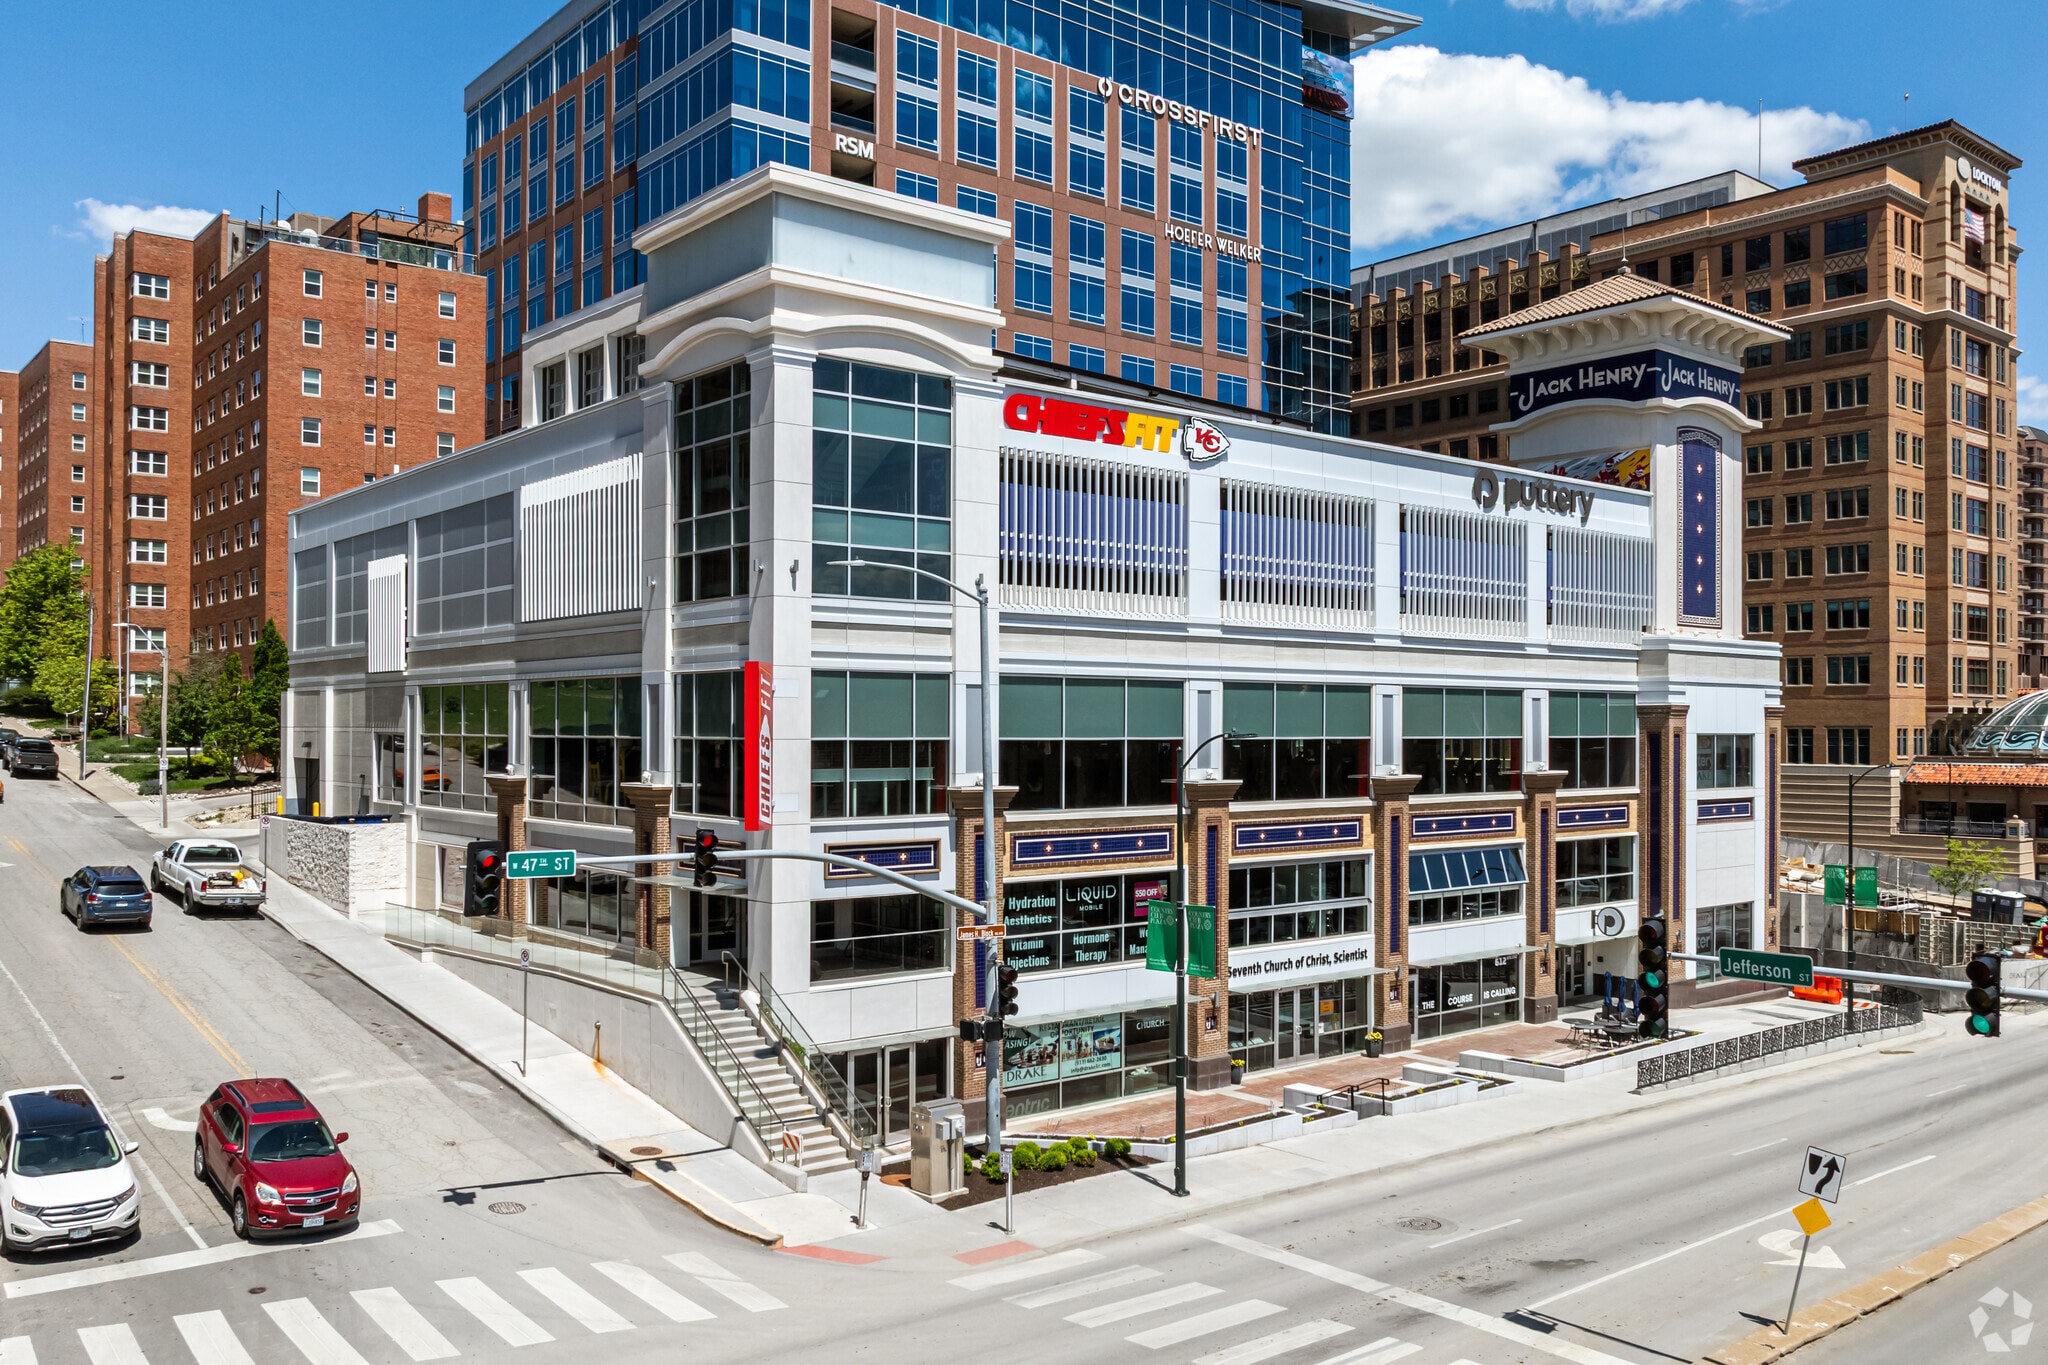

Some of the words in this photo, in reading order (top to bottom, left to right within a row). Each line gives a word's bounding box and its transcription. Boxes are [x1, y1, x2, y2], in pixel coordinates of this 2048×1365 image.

[1118, 84, 1262, 147] CROSSFIRST
[835, 133, 874, 160] RSM
[1973, 167, 2001, 192] LOCKTON
[1165, 222, 1213, 250] HOEFER
[1216, 237, 1261, 262] WELKER
[1504, 477, 1596, 524] puttery
[760, 673, 772, 712] FIT
[760, 733, 772, 820] CHIEFS
[512, 862, 518, 870] W
[554, 857, 570, 871] ST
[1065, 884, 1117, 904] LIQUID
[1135, 889, 1146, 898] $50
[1146, 888, 1158, 897] OFF
[1008, 894, 1056, 912] Hydration
[1078, 903, 1104, 912] MOBILE
[1003, 914, 1053, 926] Aesthetics
[1010, 937, 1045, 952] Vitamin
[1072, 931, 1110, 946] Hormone
[1075, 949, 1108, 963] Therapy
[1227, 961, 1262, 979] Seventh
[1264, 958, 1293, 974] Church
[1295, 956, 1305, 969] of
[1306, 953, 1332, 968] Christ,
[1333, 947, 1368, 965] Scientist
[1494, 956, 1507, 967] 612
[1723, 957, 1791, 980] Jefferson
[1799, 973, 1810, 983] ST
[1421, 1000, 1436, 1010] THE
[1447, 993, 1474, 1006] COURSE
[1483, 991, 1490, 1000] IS
[1490, 986, 1516, 998] CALLING
[1136, 1018, 1165, 1031] CHURCH
[1003, 1029, 1017, 1039] OW
[1004, 1036, 1031, 1050] ASING!
[1006, 1066, 1047, 1082] DRAKE
[1006, 1097, 1050, 1118] entric
